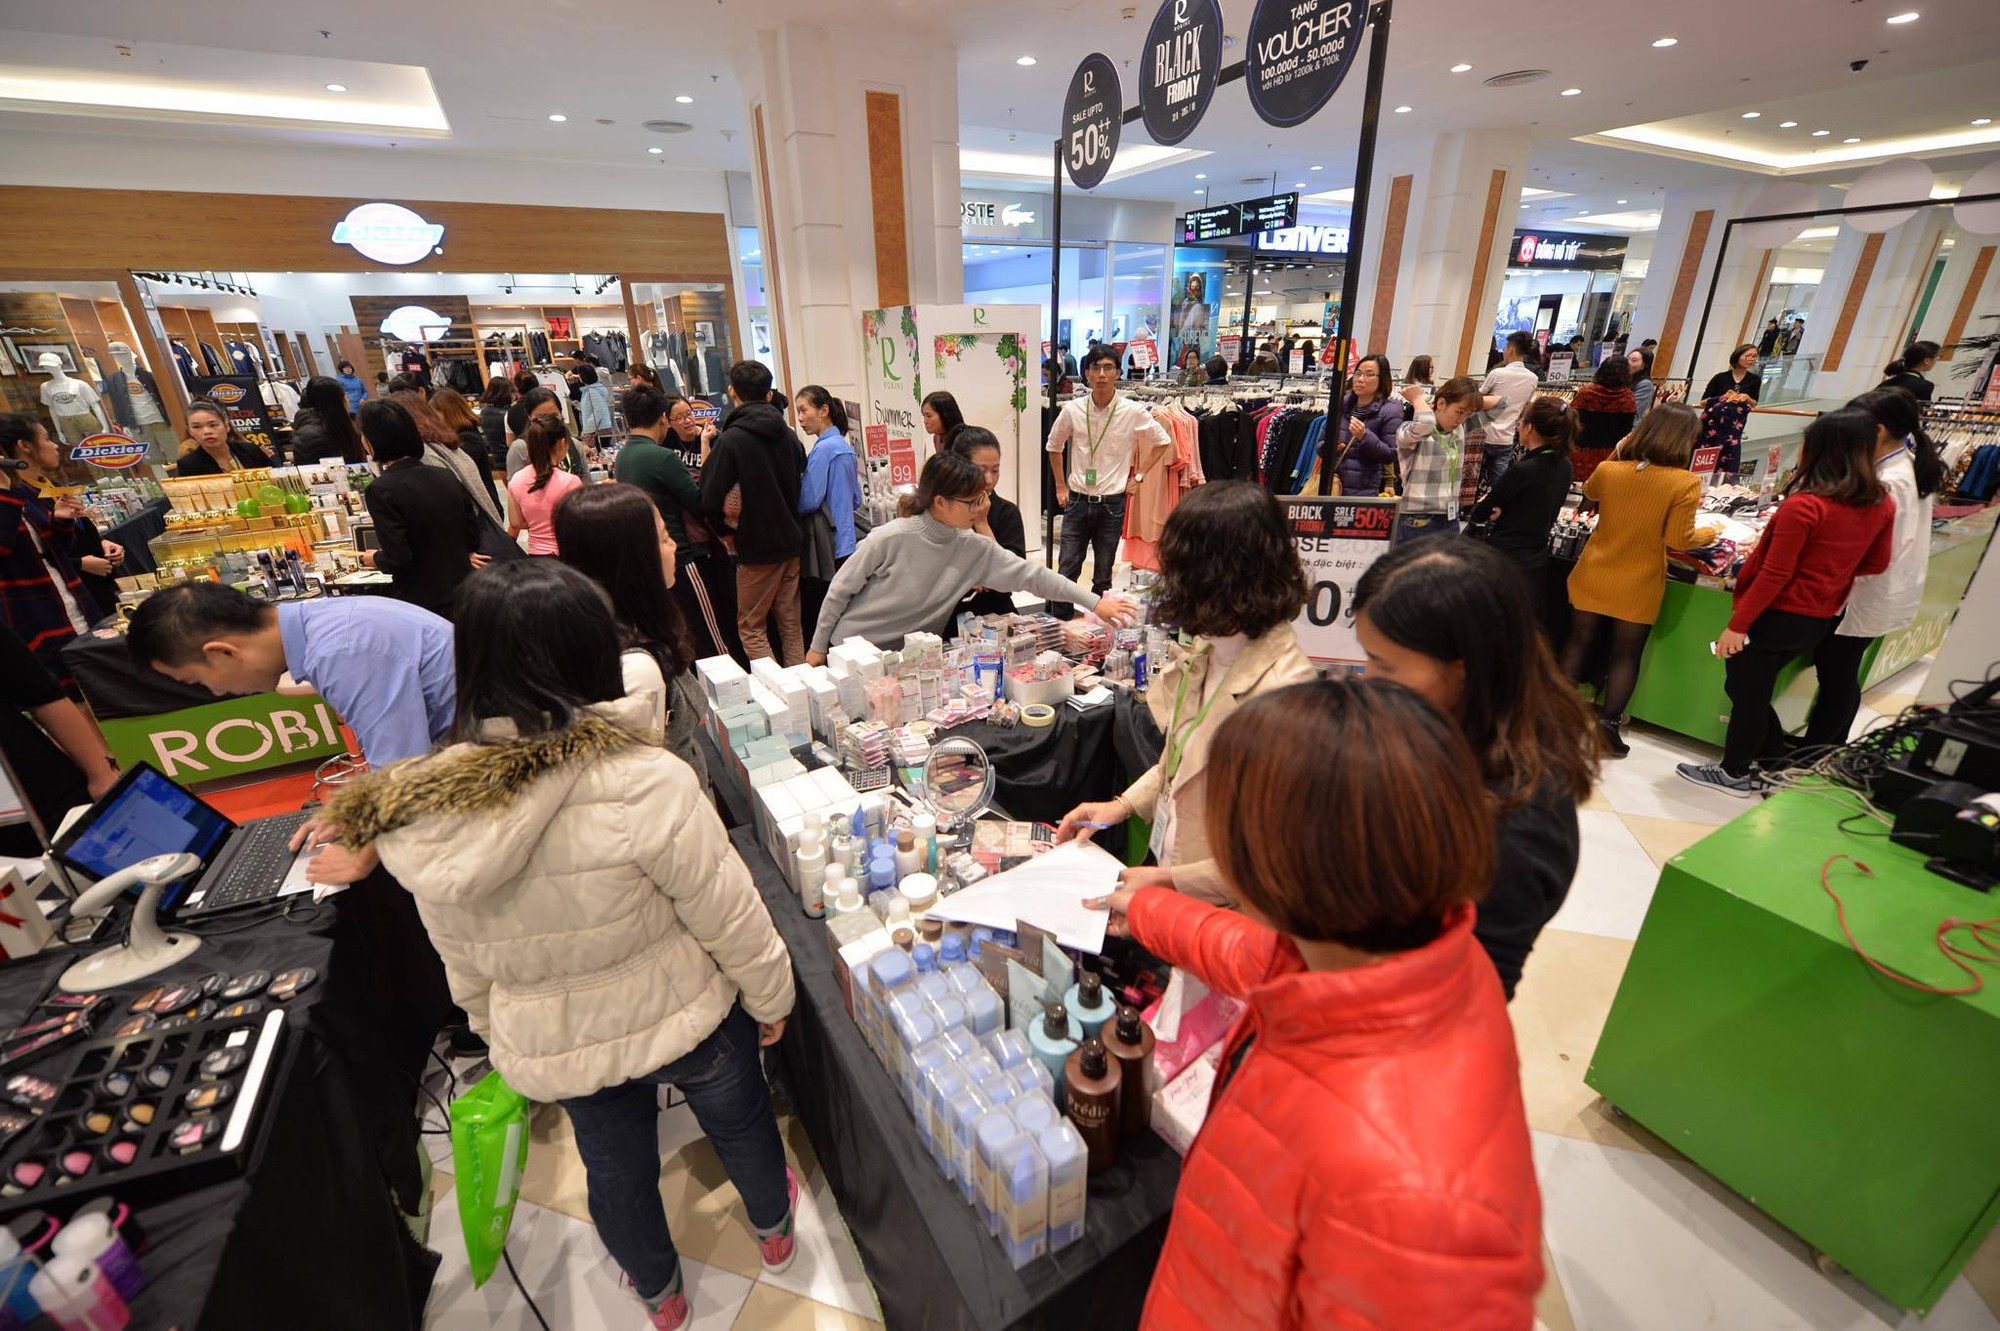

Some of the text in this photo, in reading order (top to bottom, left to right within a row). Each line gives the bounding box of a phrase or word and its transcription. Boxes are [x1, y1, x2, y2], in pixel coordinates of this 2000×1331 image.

[1258, 2, 1352, 66] VOUCHER
[1154, 24, 1203, 88] BLACK
[1307, 36, 1346, 63] 50.000đ
[1314, 61, 1321, 71] &
[1322, 53, 1341, 68] 700k
[1166, 73, 1201, 106] FRIDAY
[1072, 109, 1087, 124] SALE
[881, 337, 902, 381] R
[79, 445, 144, 457] Dickies
[870, 444, 887, 457] 65
[1695, 453, 1716, 467] SALE
[893, 465, 912, 482] 99
[1288, 505, 1323, 520] BLACK
[1335, 506, 1355, 517] SALE
[1295, 520, 1326, 532] FRIDAY
[149, 703, 339, 777] ROBI
